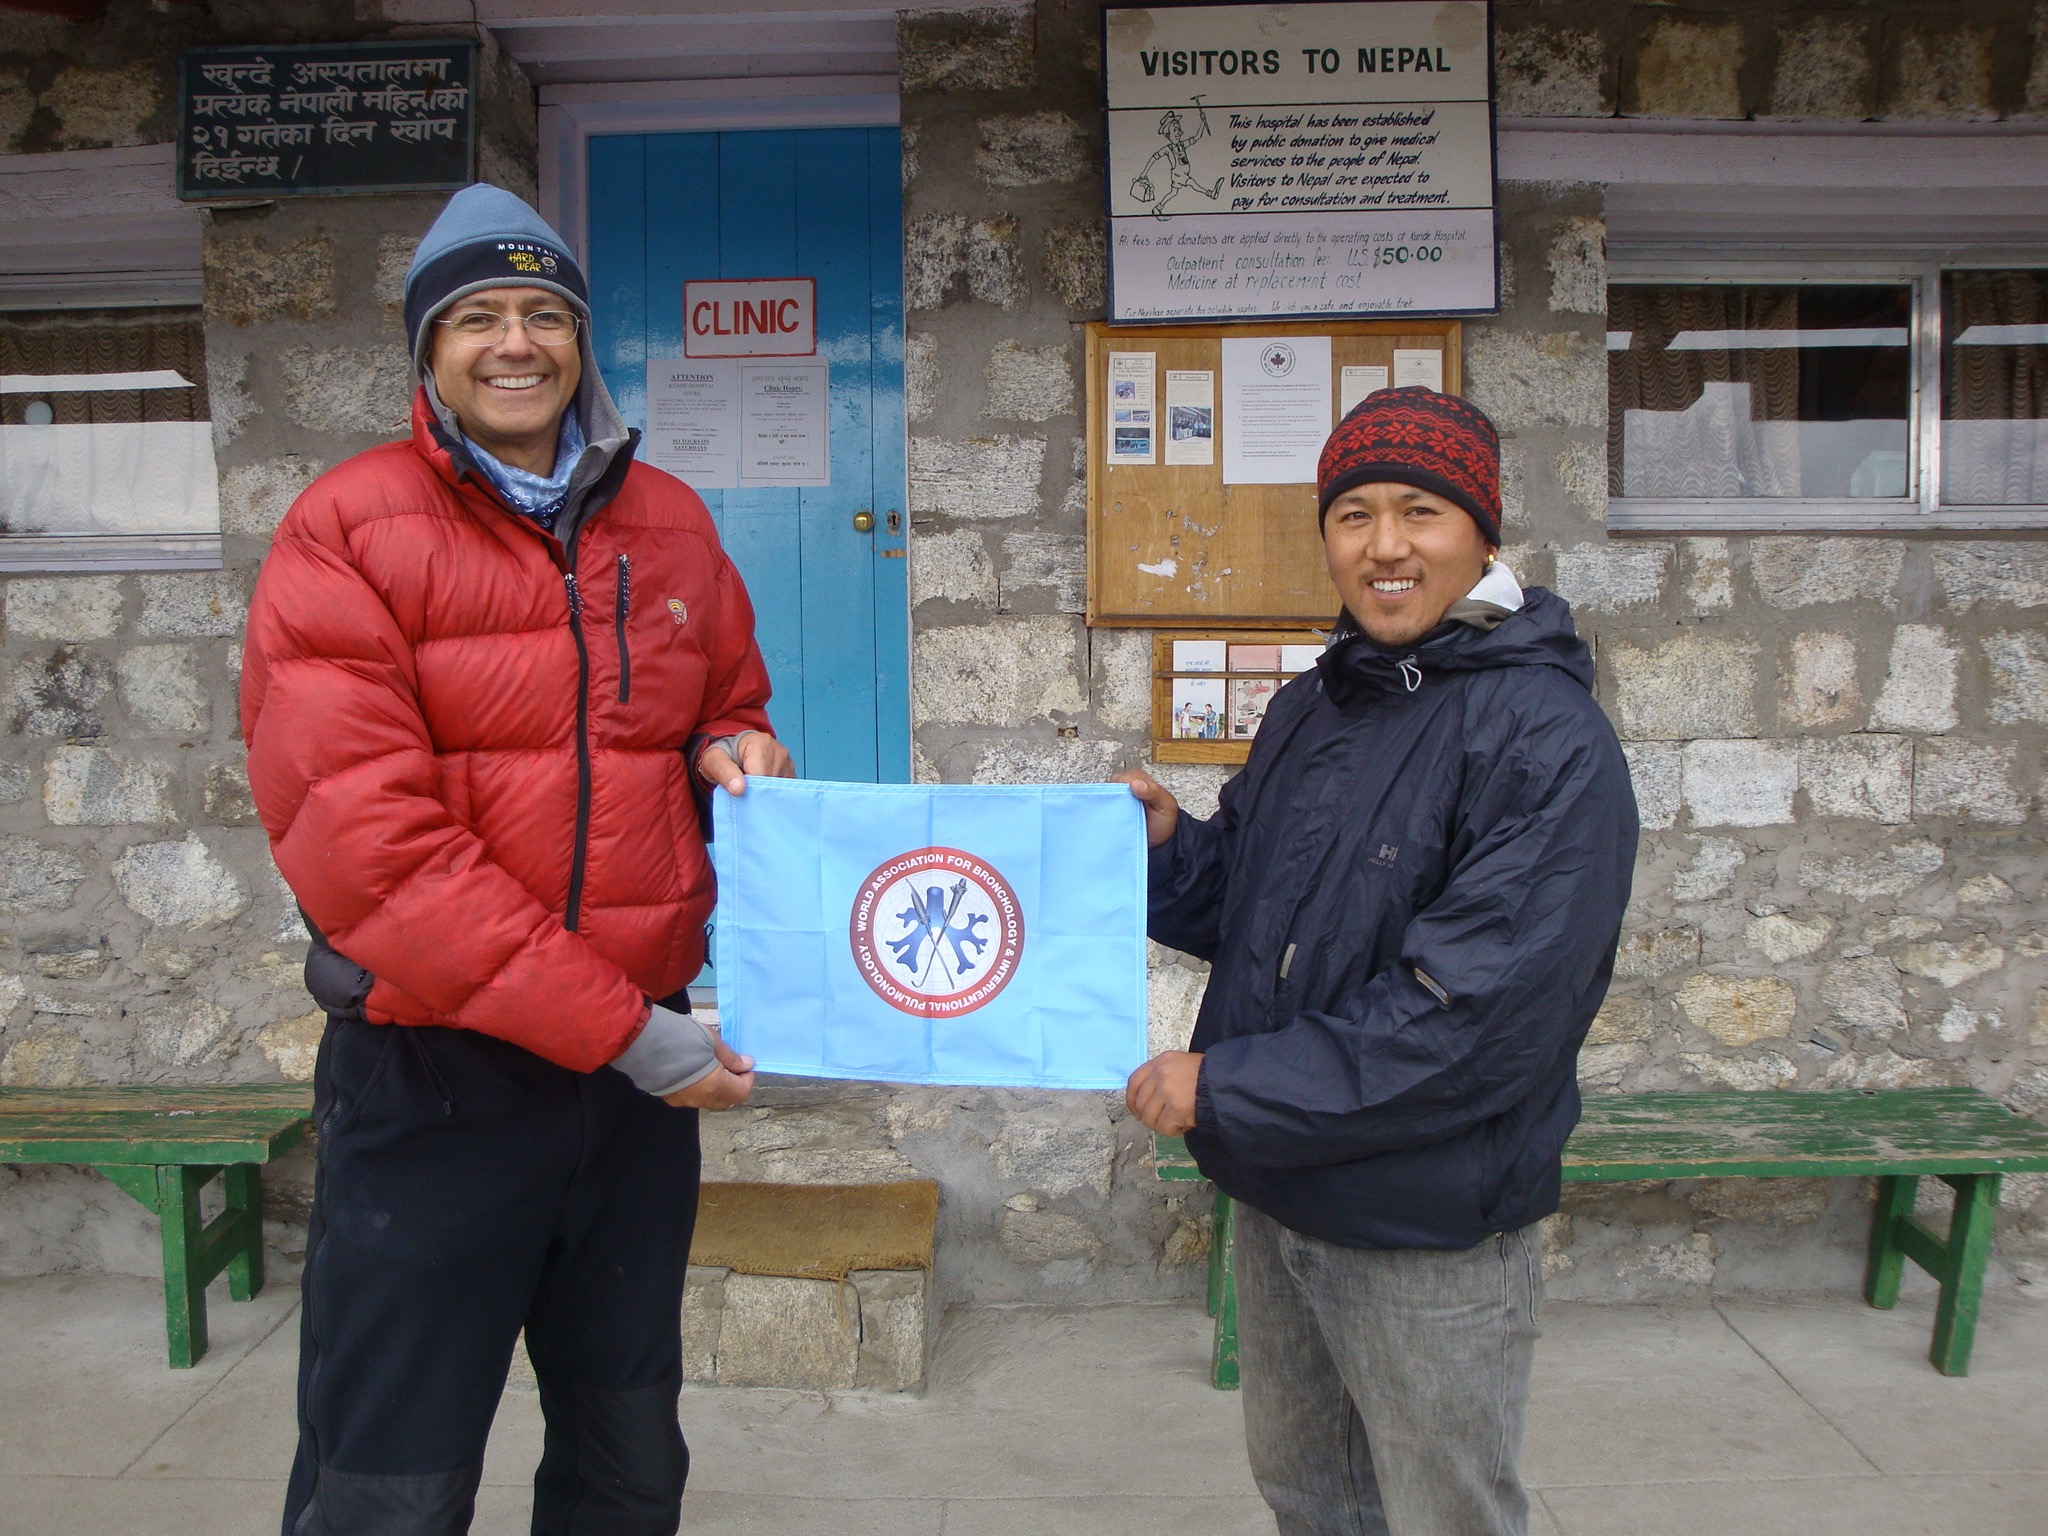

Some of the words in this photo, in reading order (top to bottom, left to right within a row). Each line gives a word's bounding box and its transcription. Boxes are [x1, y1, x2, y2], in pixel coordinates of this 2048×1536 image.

[291, 58, 452, 85] अस्पतालमा
[1140, 49, 1280, 76] VISITORS
[1302, 48, 1341, 73] TO
[1357, 47, 1451, 73] NEPAL
[193, 88, 271, 118] प्रत्येक
[279, 85, 358, 116] नेपाली
[362, 81, 468, 118] महिनाको
[192, 125, 229, 150] २१
[236, 117, 315, 149] गतेका
[321, 115, 378, 147] दिन
[390, 112, 457, 144] खोप
[1229, 114, 1252, 129] This
[1256, 113, 1305, 132] hospital
[1306, 113, 1330, 128] has
[1331, 113, 1359, 127] been
[1362, 110, 1435, 127] established
[1231, 134, 1248, 153] by
[1249, 134, 1286, 152] public
[1290, 133, 1344, 148] donation
[1349, 133, 1361, 146] to
[1360, 133, 1388, 151] give
[1390, 130, 1440, 146] medical
[1230, 154, 1286, 168] services
[1290, 153, 1304, 166] to
[1306, 152, 1326, 166] the
[1327, 152, 1365, 170] people
[1368, 150, 1387, 166] of
[1386, 151, 1423, 169] Nepal.
[1230, 172, 1277, 188] Visitors
[1281, 173, 1294, 186] to
[1296, 172, 1334, 190] Nepal
[1335, 175, 1358, 186] are
[1361, 171, 1415, 189] expected
[1417, 171, 1430, 184] to
[1231, 195, 1254, 211] pay
[1256, 191, 1279, 207] for
[1281, 191, 1356, 206] consultation
[1359, 190, 1386, 205] and
[1387, 190, 1450, 205] treatment.
[498, 243, 559, 259] MOUNTAIN
[1132, 234, 1150, 247] fees
[1155, 234, 1174, 246] and
[1177, 233, 1218, 246] donations
[1221, 235, 1235, 245] are
[1239, 231, 1270, 249] applied
[1273, 231, 1302, 248] directly
[1306, 232, 1315, 243] to
[1316, 231, 1327, 243] the
[1331, 231, 1370, 247] operating
[1372, 231, 1394, 243] costs
[1409, 229, 1431, 242] Kunde
[508, 252, 535, 263] HARD
[516, 262, 542, 272] WEAR
[1166, 254, 1225, 275] Outpatient
[1235, 250, 1305, 270] consultation
[1167, 274, 1218, 291] Medicine
[1225, 275, 1239, 289] at
[1245, 270, 1327, 297] replacement
[1335, 272, 1362, 289] cost
[692, 298, 800, 336] CLINIC
[1339, 299, 1355, 310] and
[871, 853, 944, 892] ASSOCIATION
[947, 854, 973, 871] FOR
[857, 890, 875, 932] WORLD
[972, 865, 1018, 946] BRONCHOLOGY
[858, 944, 926, 1011] PULMONOLOGY
[928, 959, 1012, 1012] INTERVENTIONAL
